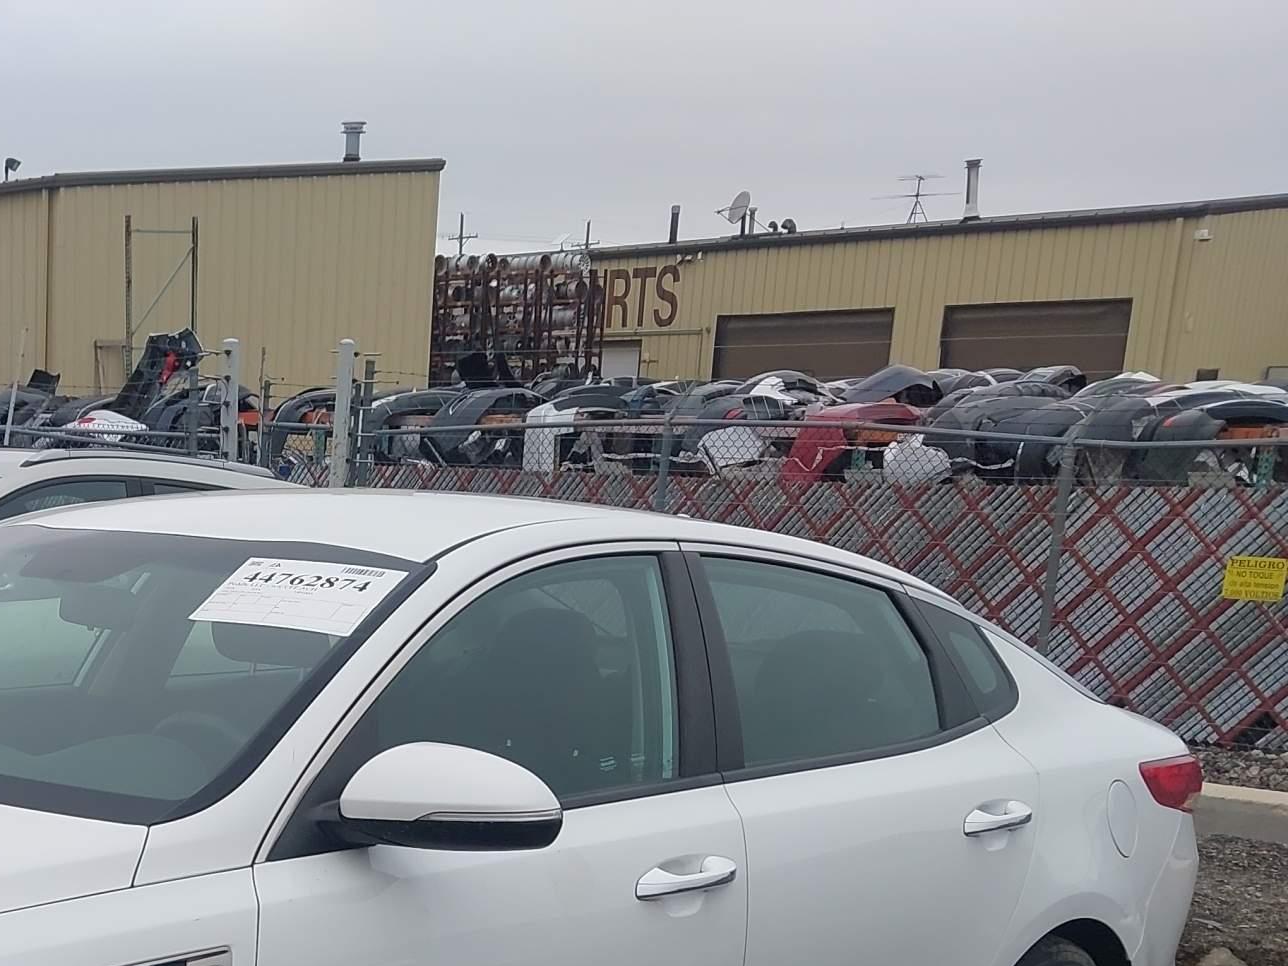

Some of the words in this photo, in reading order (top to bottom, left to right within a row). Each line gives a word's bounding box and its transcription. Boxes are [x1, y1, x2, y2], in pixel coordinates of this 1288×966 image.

[1231, 559, 1286, 571] PELIGRO
[1236, 570, 1247, 578] NO
[1249, 571, 1275, 580] TOQUE
[242, 571, 373, 593] 44762874
